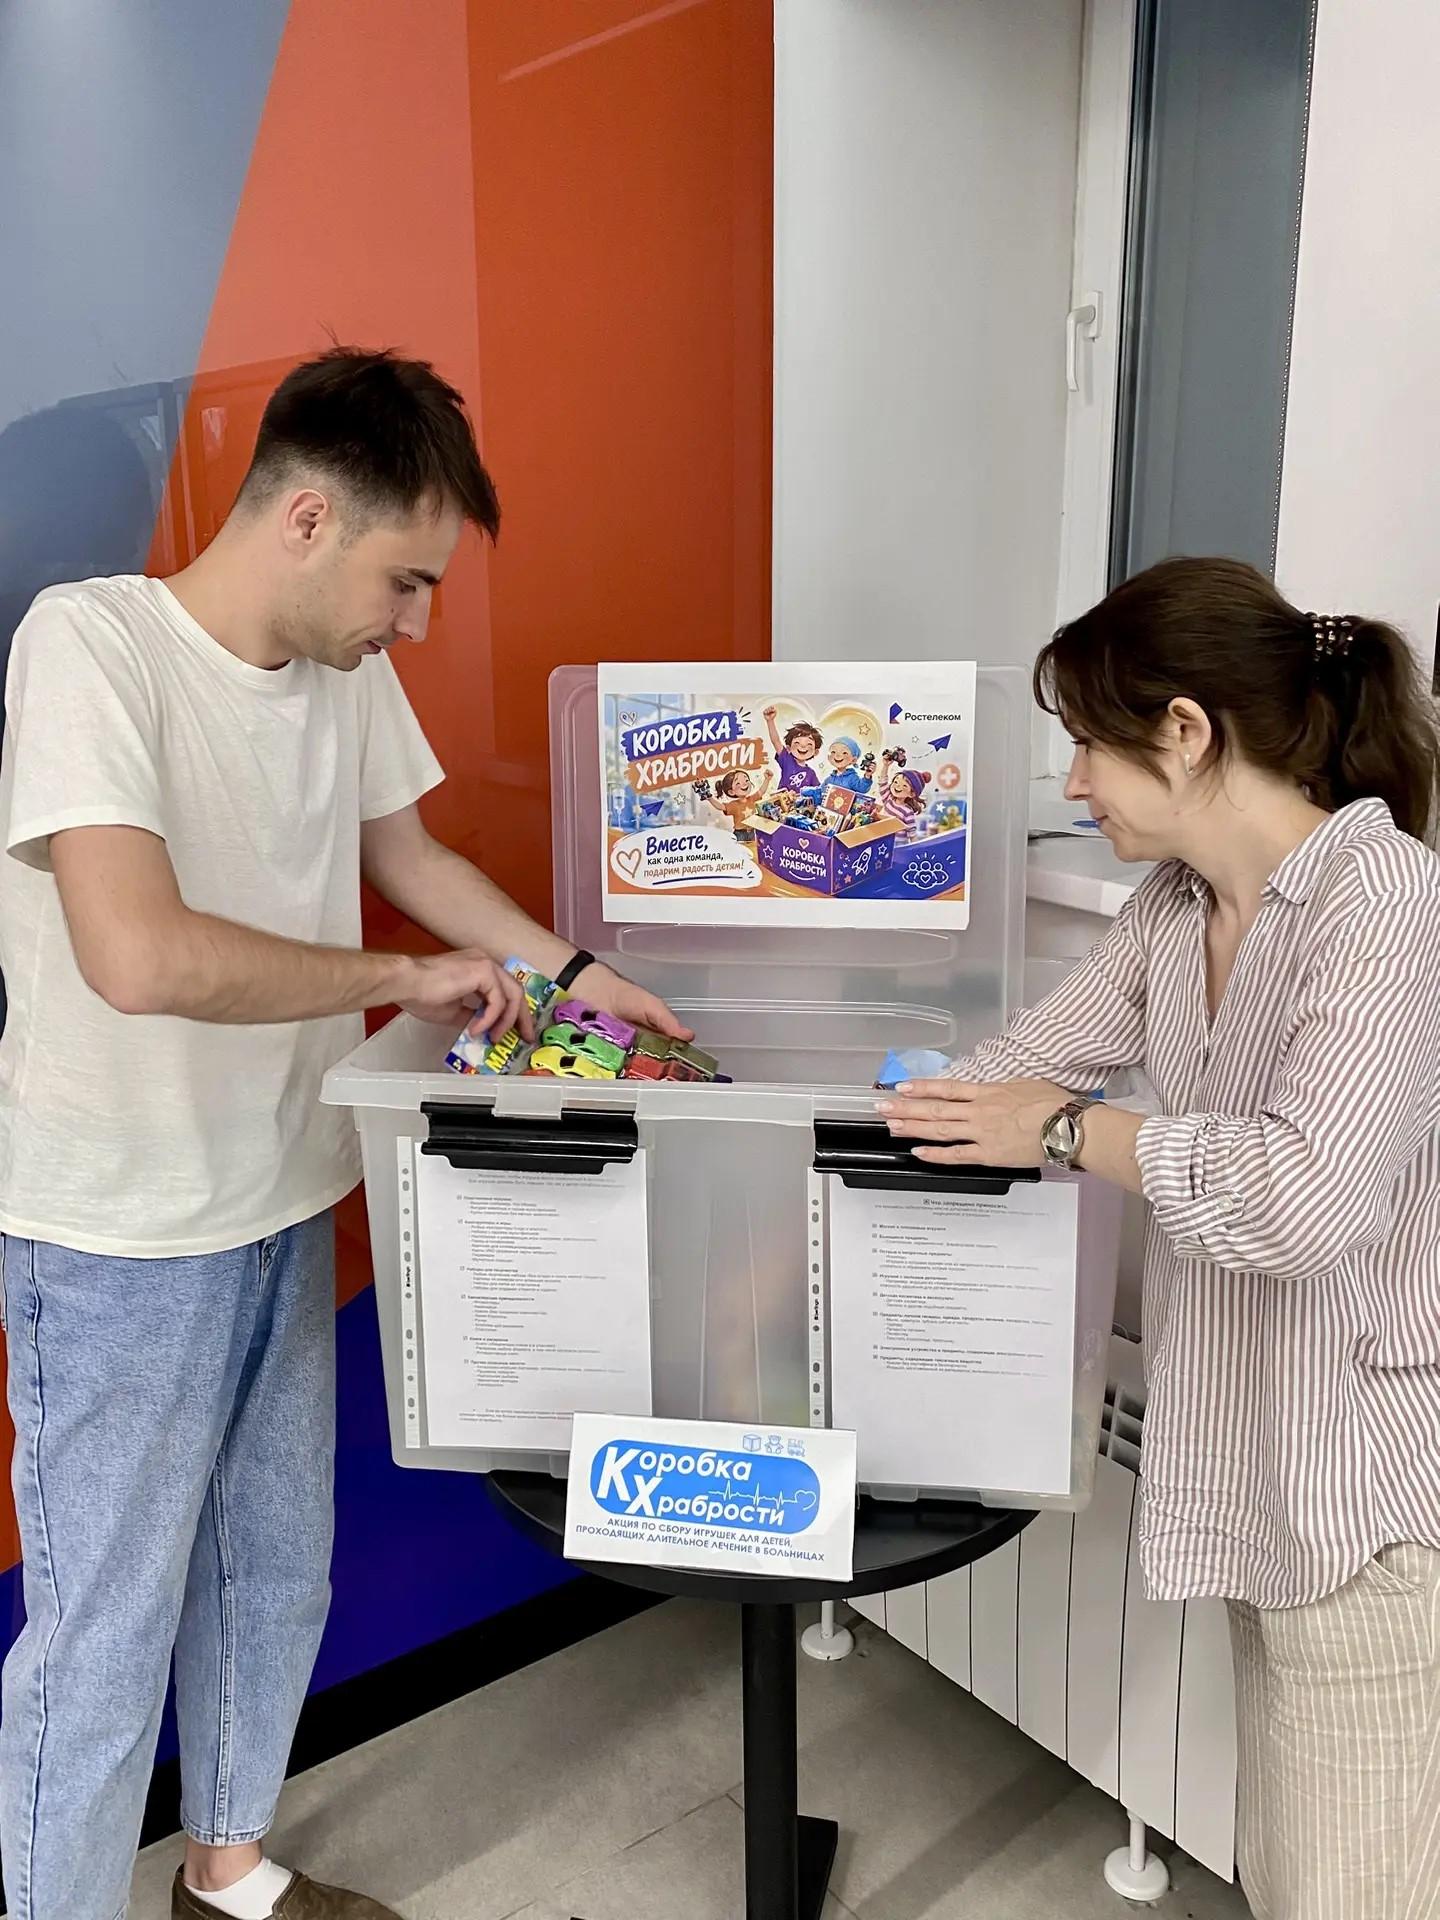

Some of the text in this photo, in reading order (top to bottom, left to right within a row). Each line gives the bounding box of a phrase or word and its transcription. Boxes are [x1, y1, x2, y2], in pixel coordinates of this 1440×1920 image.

[904, 711, 962, 723] Ростелеком
[632, 714, 732, 757] КОРОБКА
[635, 742, 756, 790] ХРАБРОСТИ
[646, 835, 708, 856] Вместе,
[782, 845, 826, 867] КОРОБКА
[643, 859, 745, 878] подарим радость детям!
[647, 853, 724, 865] как одна команда,
[779, 856, 827, 877] ХРАБРОСТИ
[597, 1447, 752, 1501] Коробка
[625, 1474, 785, 1526] Храбрости
[576, 1524, 825, 1561] ПРОХОДЯЩИХ ДЛИТЕЛЬНОЕ ЛЕЧЕНИЕ В БОЛЬНИЦАХ
[607, 1518, 793, 1548] АКЦИЯ ПО СБОРУ ИГРУШЕК ДЛЯ ДЕТЕЙ,
